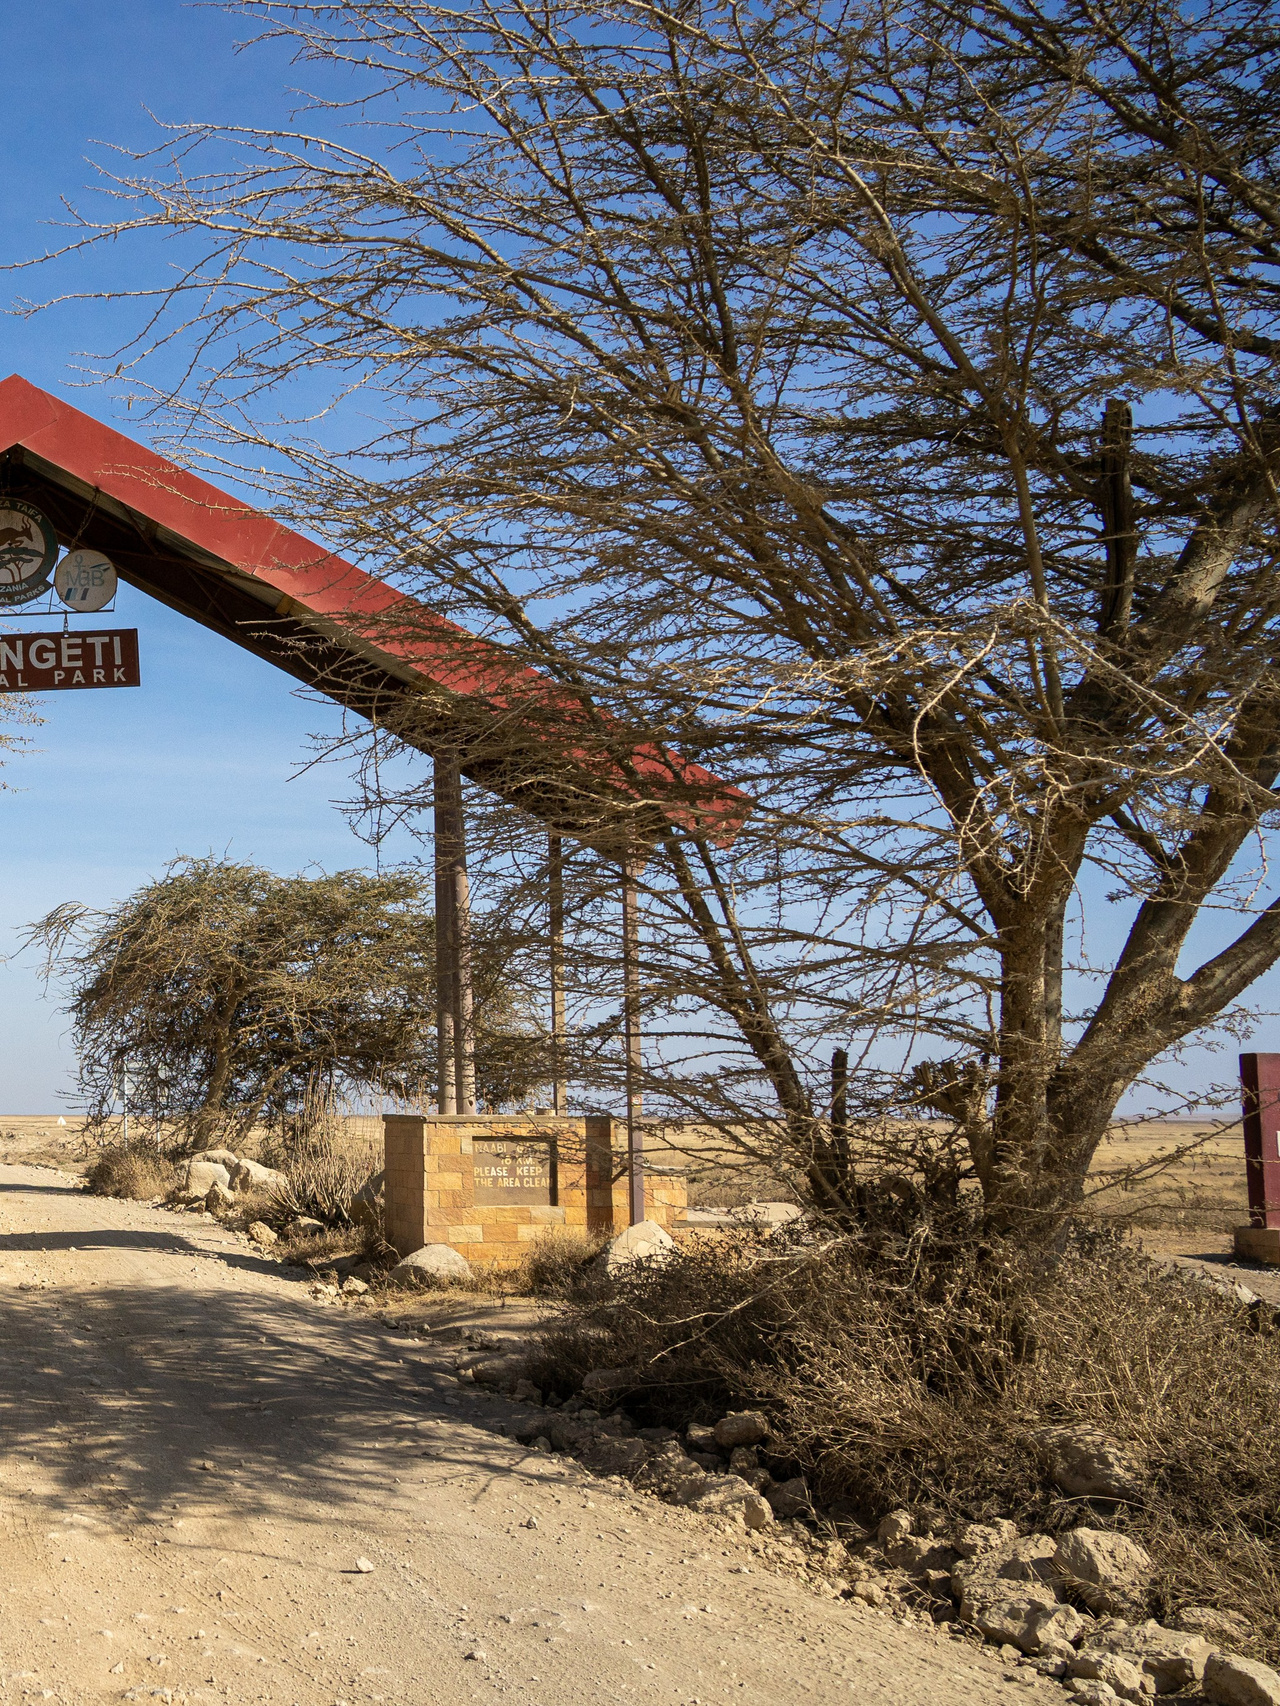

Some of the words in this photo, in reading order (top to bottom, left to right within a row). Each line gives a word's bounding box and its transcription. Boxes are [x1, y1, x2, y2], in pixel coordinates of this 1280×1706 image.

[16, 502, 42, 523] TAIFA
[14, 584, 45, 602] PARKS
[54, 667, 126, 685] PARK
[475, 1143, 507, 1153] NAABI
[474, 1166, 508, 1176] PLEASE
[516, 1166, 543, 1176] KEEP
[474, 1178, 493, 1187] THE
[497, 1177, 521, 1187] AREA
